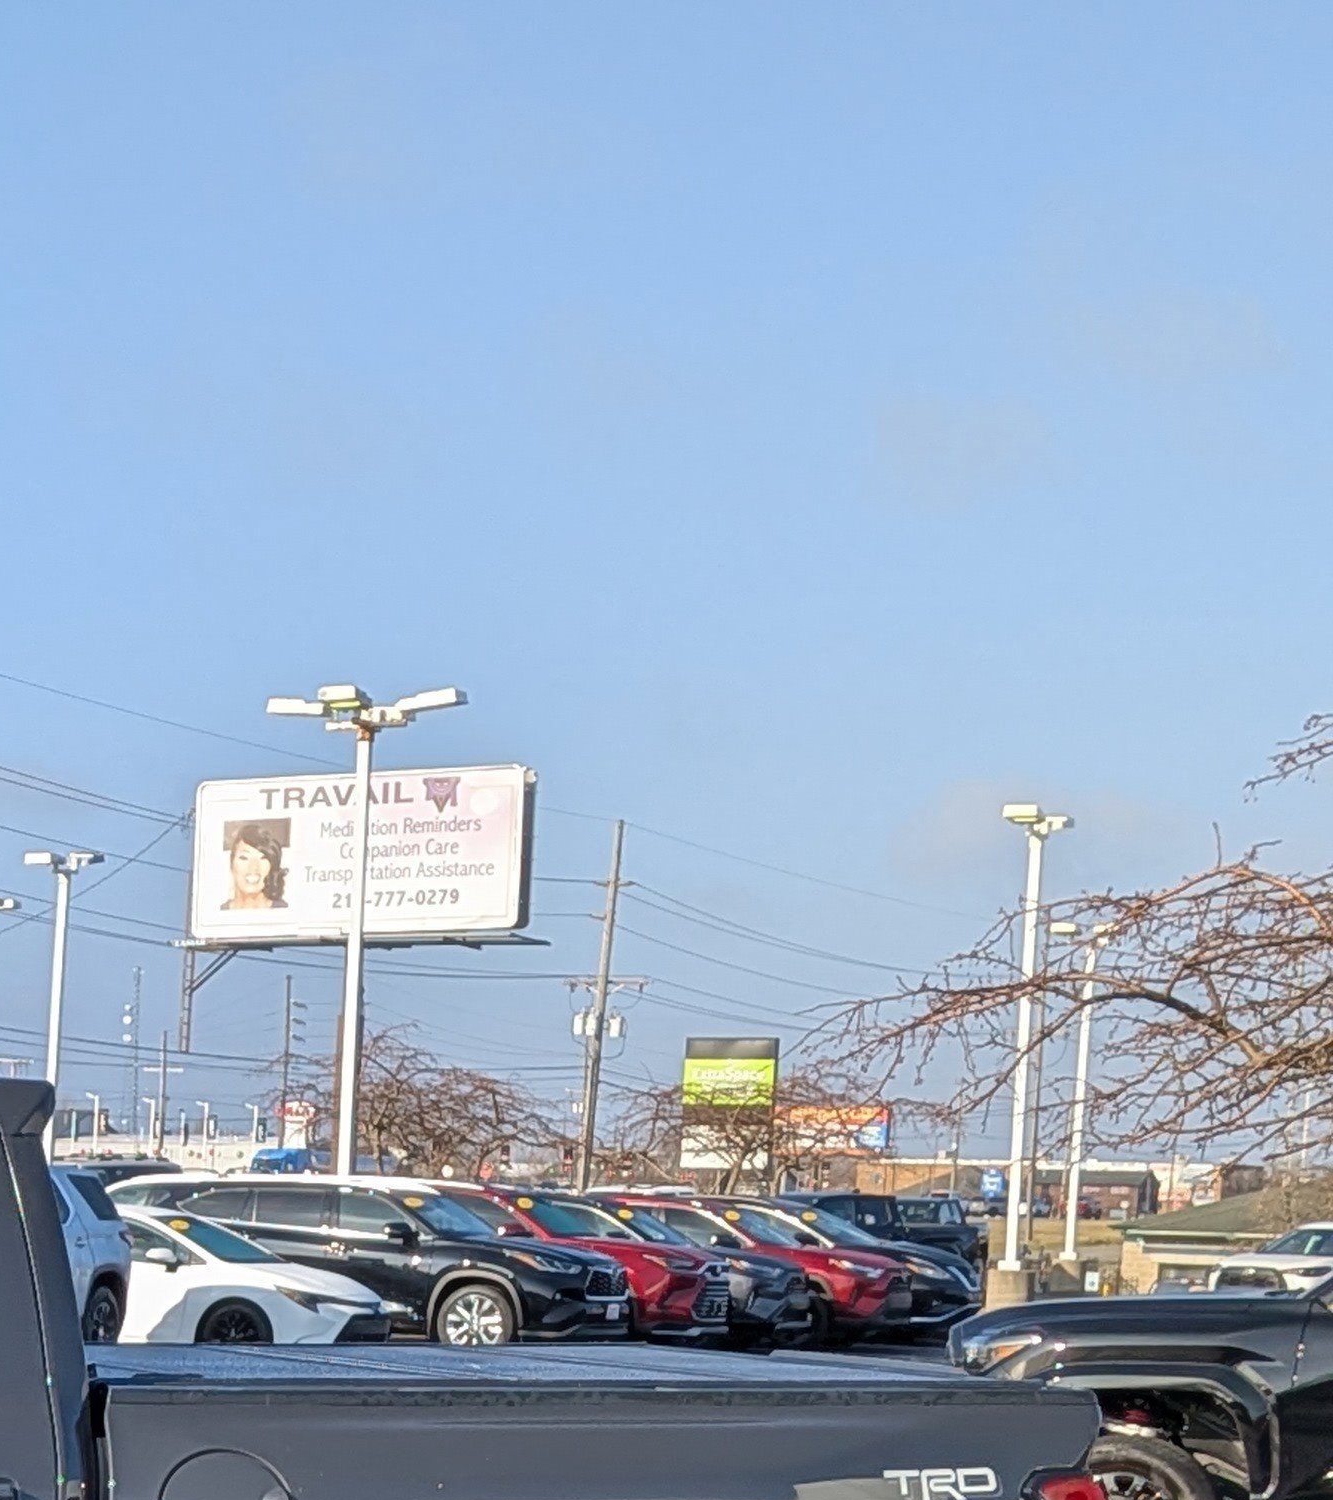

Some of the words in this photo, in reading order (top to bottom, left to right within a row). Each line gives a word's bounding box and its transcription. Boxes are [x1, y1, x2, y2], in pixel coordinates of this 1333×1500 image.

[320, 820, 398, 838] Medition
[403, 817, 482, 834] Reminders
[339, 840, 421, 862] Copanion
[425, 837, 460, 855] Care
[304, 863, 411, 885] Transptation
[416, 861, 495, 879] Assistance
[332, 888, 460, 909] 21-777-0279
